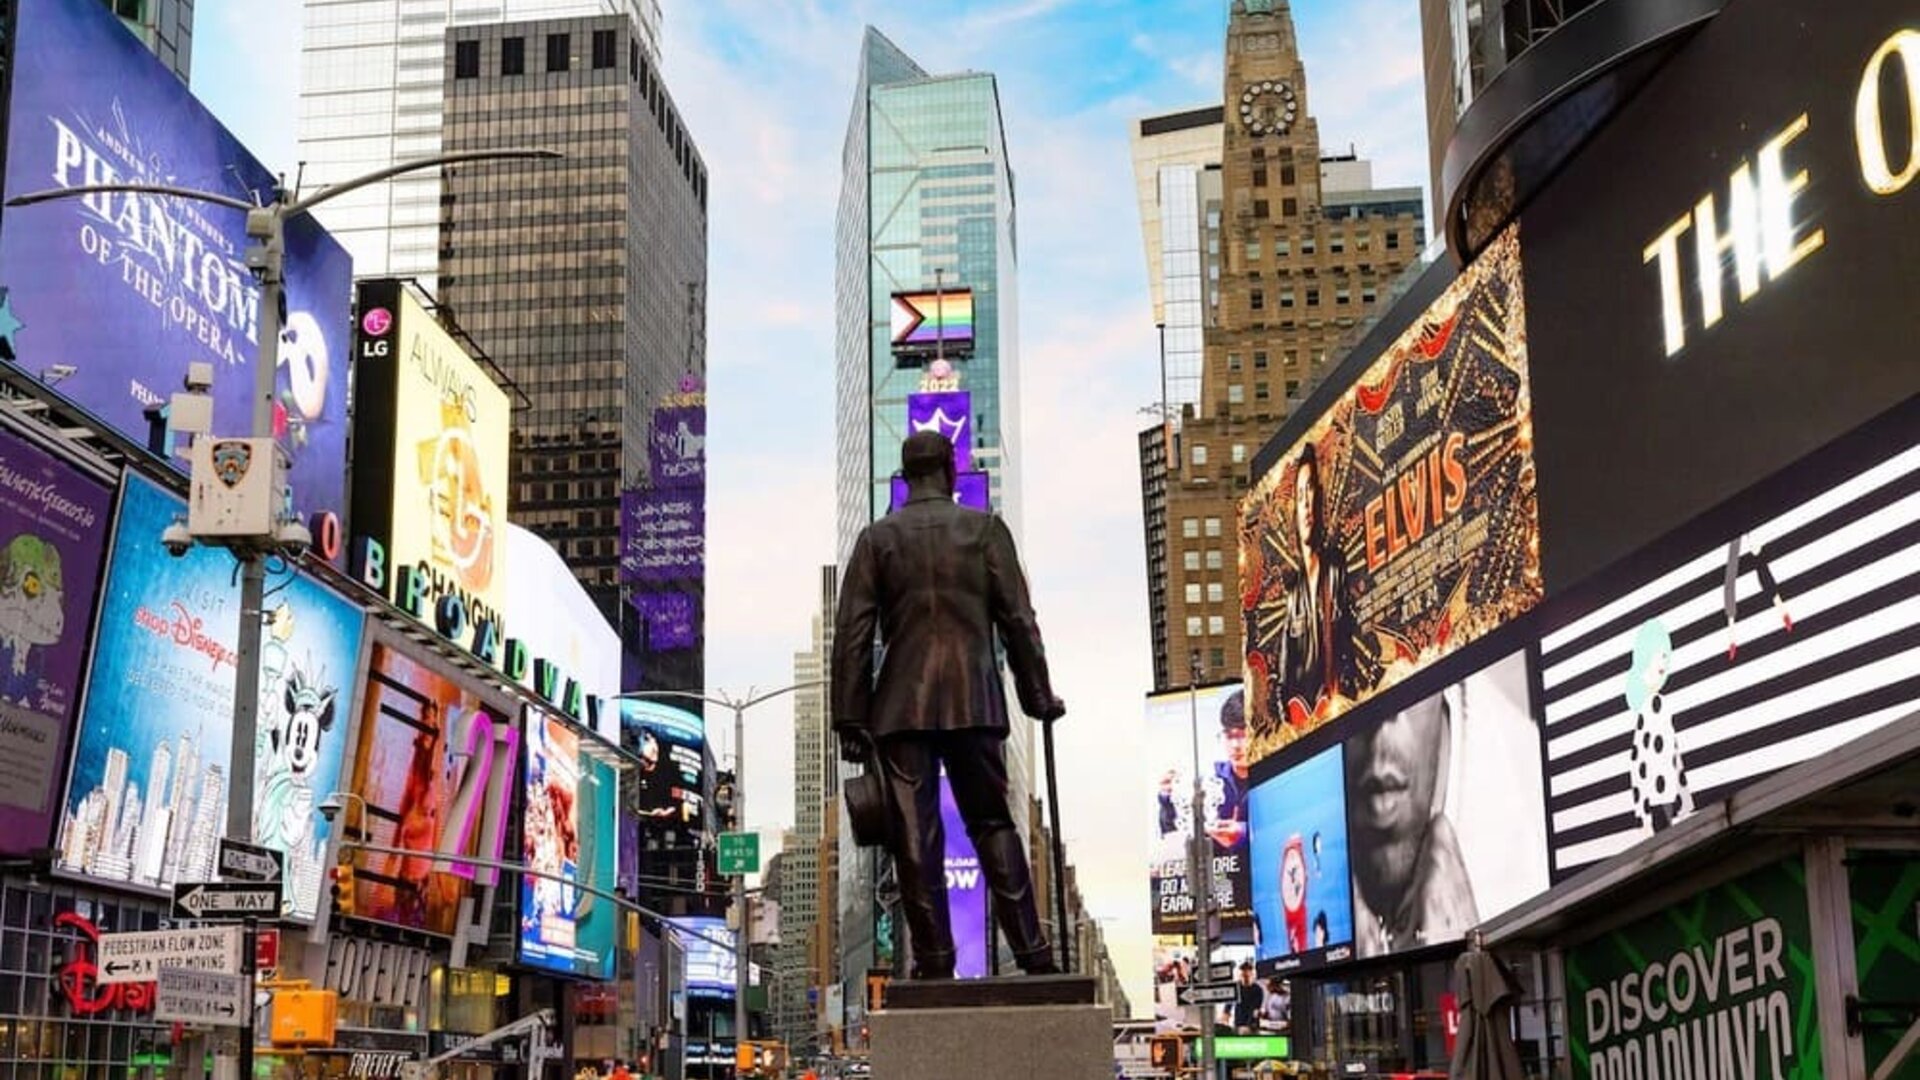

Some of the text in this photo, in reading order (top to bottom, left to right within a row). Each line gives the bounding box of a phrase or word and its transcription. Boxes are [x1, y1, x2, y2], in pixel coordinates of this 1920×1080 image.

[48, 114, 260, 346] PHANTOM
[1643, 112, 1824, 357] THE
[80, 224, 236, 365] OF THE OPERA
[363, 340, 388, 357] LG
[409, 333, 477, 424] ALWAYS
[921, 378, 958, 392] 2022
[1364, 431, 1467, 574] ELVIS
[180, 580, 226, 615] VISIT
[417, 559, 507, 648] CHANGIN
[356, 535, 604, 733] BROADWAY
[434, 711, 519, 888] 21
[228, 852, 274, 870] ONE WAY
[944, 870, 978, 889] OW
[189, 894, 268, 908] ONE WAY
[1160, 895, 1195, 913] EARN
[103, 934, 226, 955] PEDESTRIAN FLOW ZONE
[158, 955, 226, 970] KEEP MOVING
[324, 932, 433, 1011] FOREVER
[1585, 917, 1786, 1044] DISCOVER
[349, 1053, 394, 1079] FOREVER
